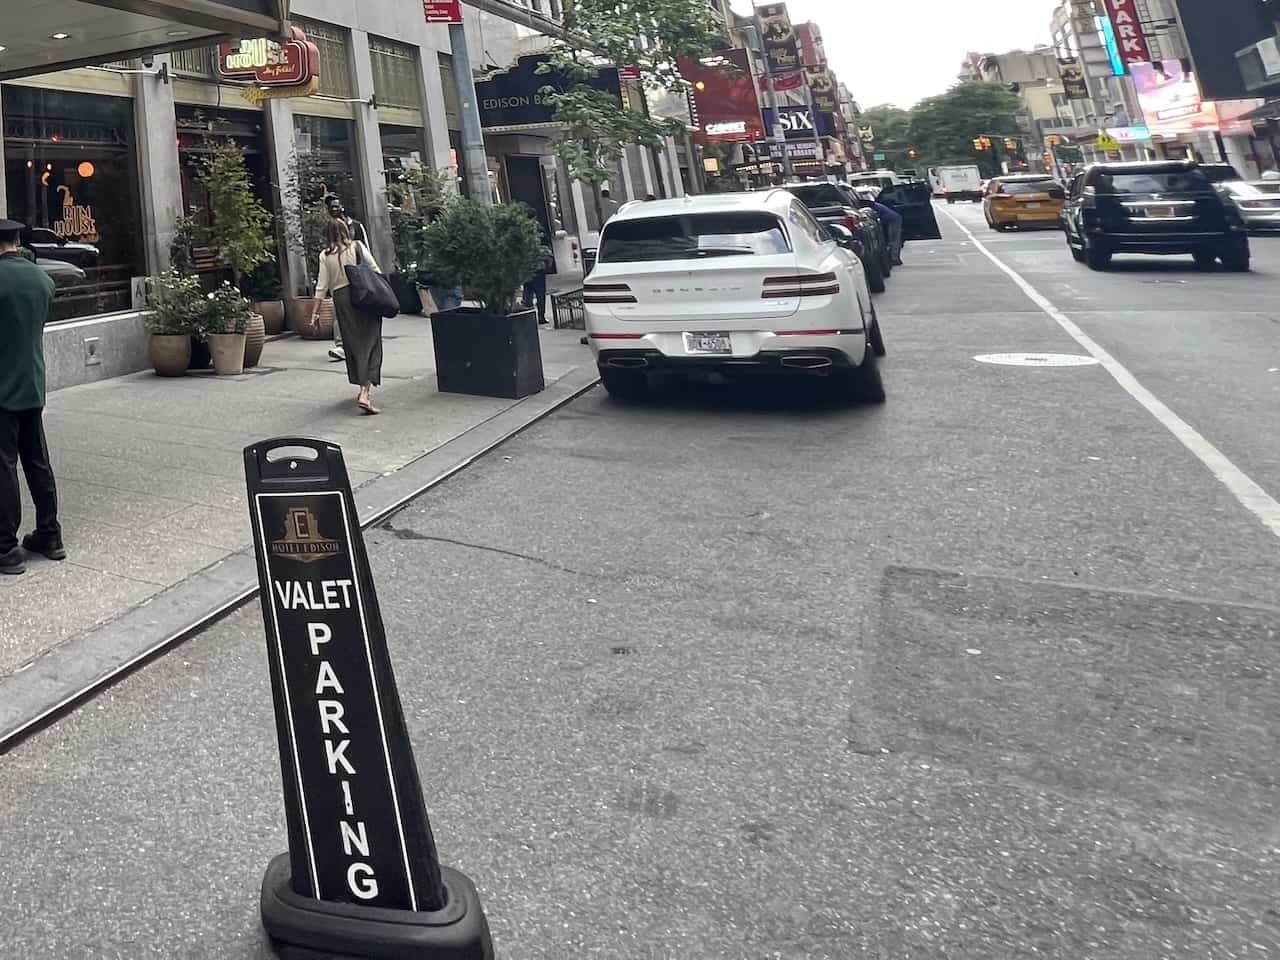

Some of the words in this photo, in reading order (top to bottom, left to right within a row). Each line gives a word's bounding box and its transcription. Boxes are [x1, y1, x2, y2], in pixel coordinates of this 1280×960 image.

[482, 95, 530, 110] EDISON
[275, 578, 352, 610] VALET
[307, 622, 379, 900] PARKING
